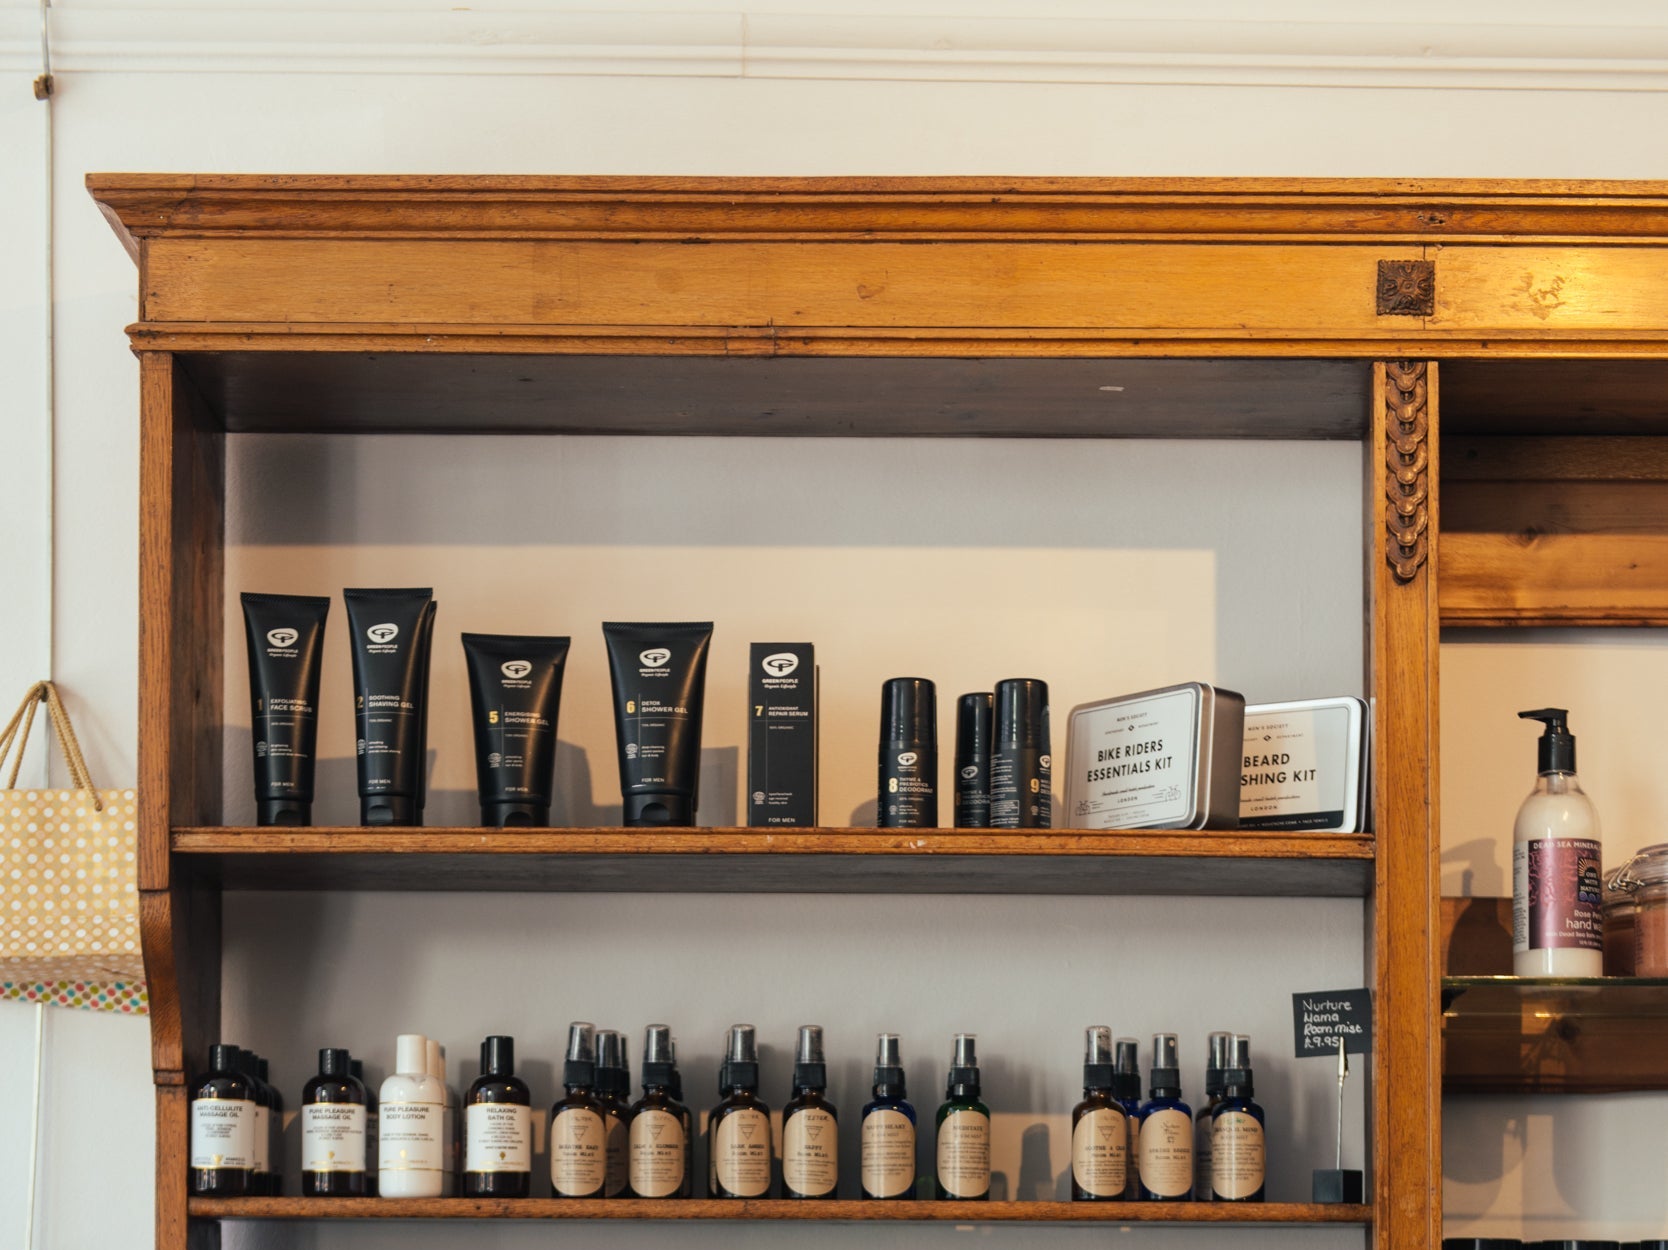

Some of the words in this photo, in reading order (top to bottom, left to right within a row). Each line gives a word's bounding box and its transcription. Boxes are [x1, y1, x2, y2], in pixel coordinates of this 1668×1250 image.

[626, 701, 636, 714] 6
[755, 705, 764, 717] 7
[489, 710, 499, 724] 5
[1098, 747, 1121, 762] BIKE
[1124, 739, 1164, 757] RIDERS
[1244, 753, 1290, 768] BEARD
[1087, 761, 1151, 783] ESSENTIALS
[1155, 756, 1173, 771] KIT
[888, 777, 898, 793] 8
[1241, 772, 1287, 786] SHING
[1294, 769, 1317, 783] KIT
[1030, 778, 1040, 793] 9
[1566, 917, 1592, 929] hand
[1303, 998, 1352, 1011] Nurture
